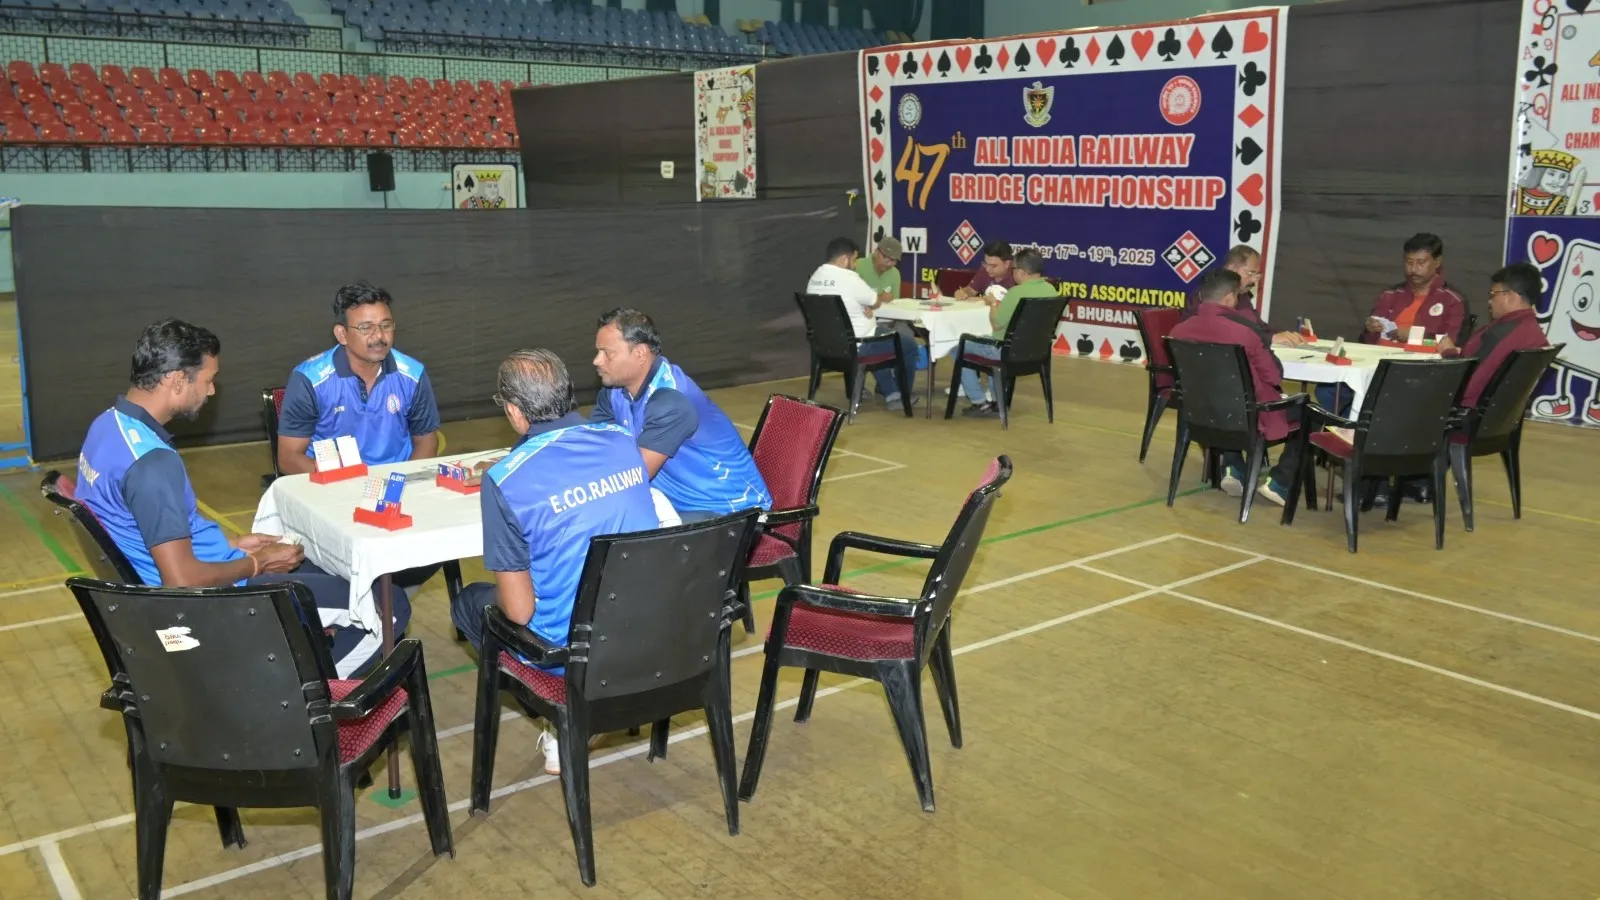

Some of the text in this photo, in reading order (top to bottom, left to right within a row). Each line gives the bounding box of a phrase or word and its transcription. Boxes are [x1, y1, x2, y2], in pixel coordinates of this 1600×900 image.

[1561, 84, 1580, 101] ALL
[975, 134, 1195, 167] ALL INDIA RAILWAY
[950, 173, 1226, 210] BRIDGE CHAMPIONSHIP
[1580, 200, 1591, 213] 3
[906, 236, 921, 251] W
[1118, 248, 1155, 266] 2025
[1090, 284, 1186, 308] ASSOCIATION
[390, 474, 405, 483] ALERT
[550, 466, 643, 514] E.CO.RAILWAY
